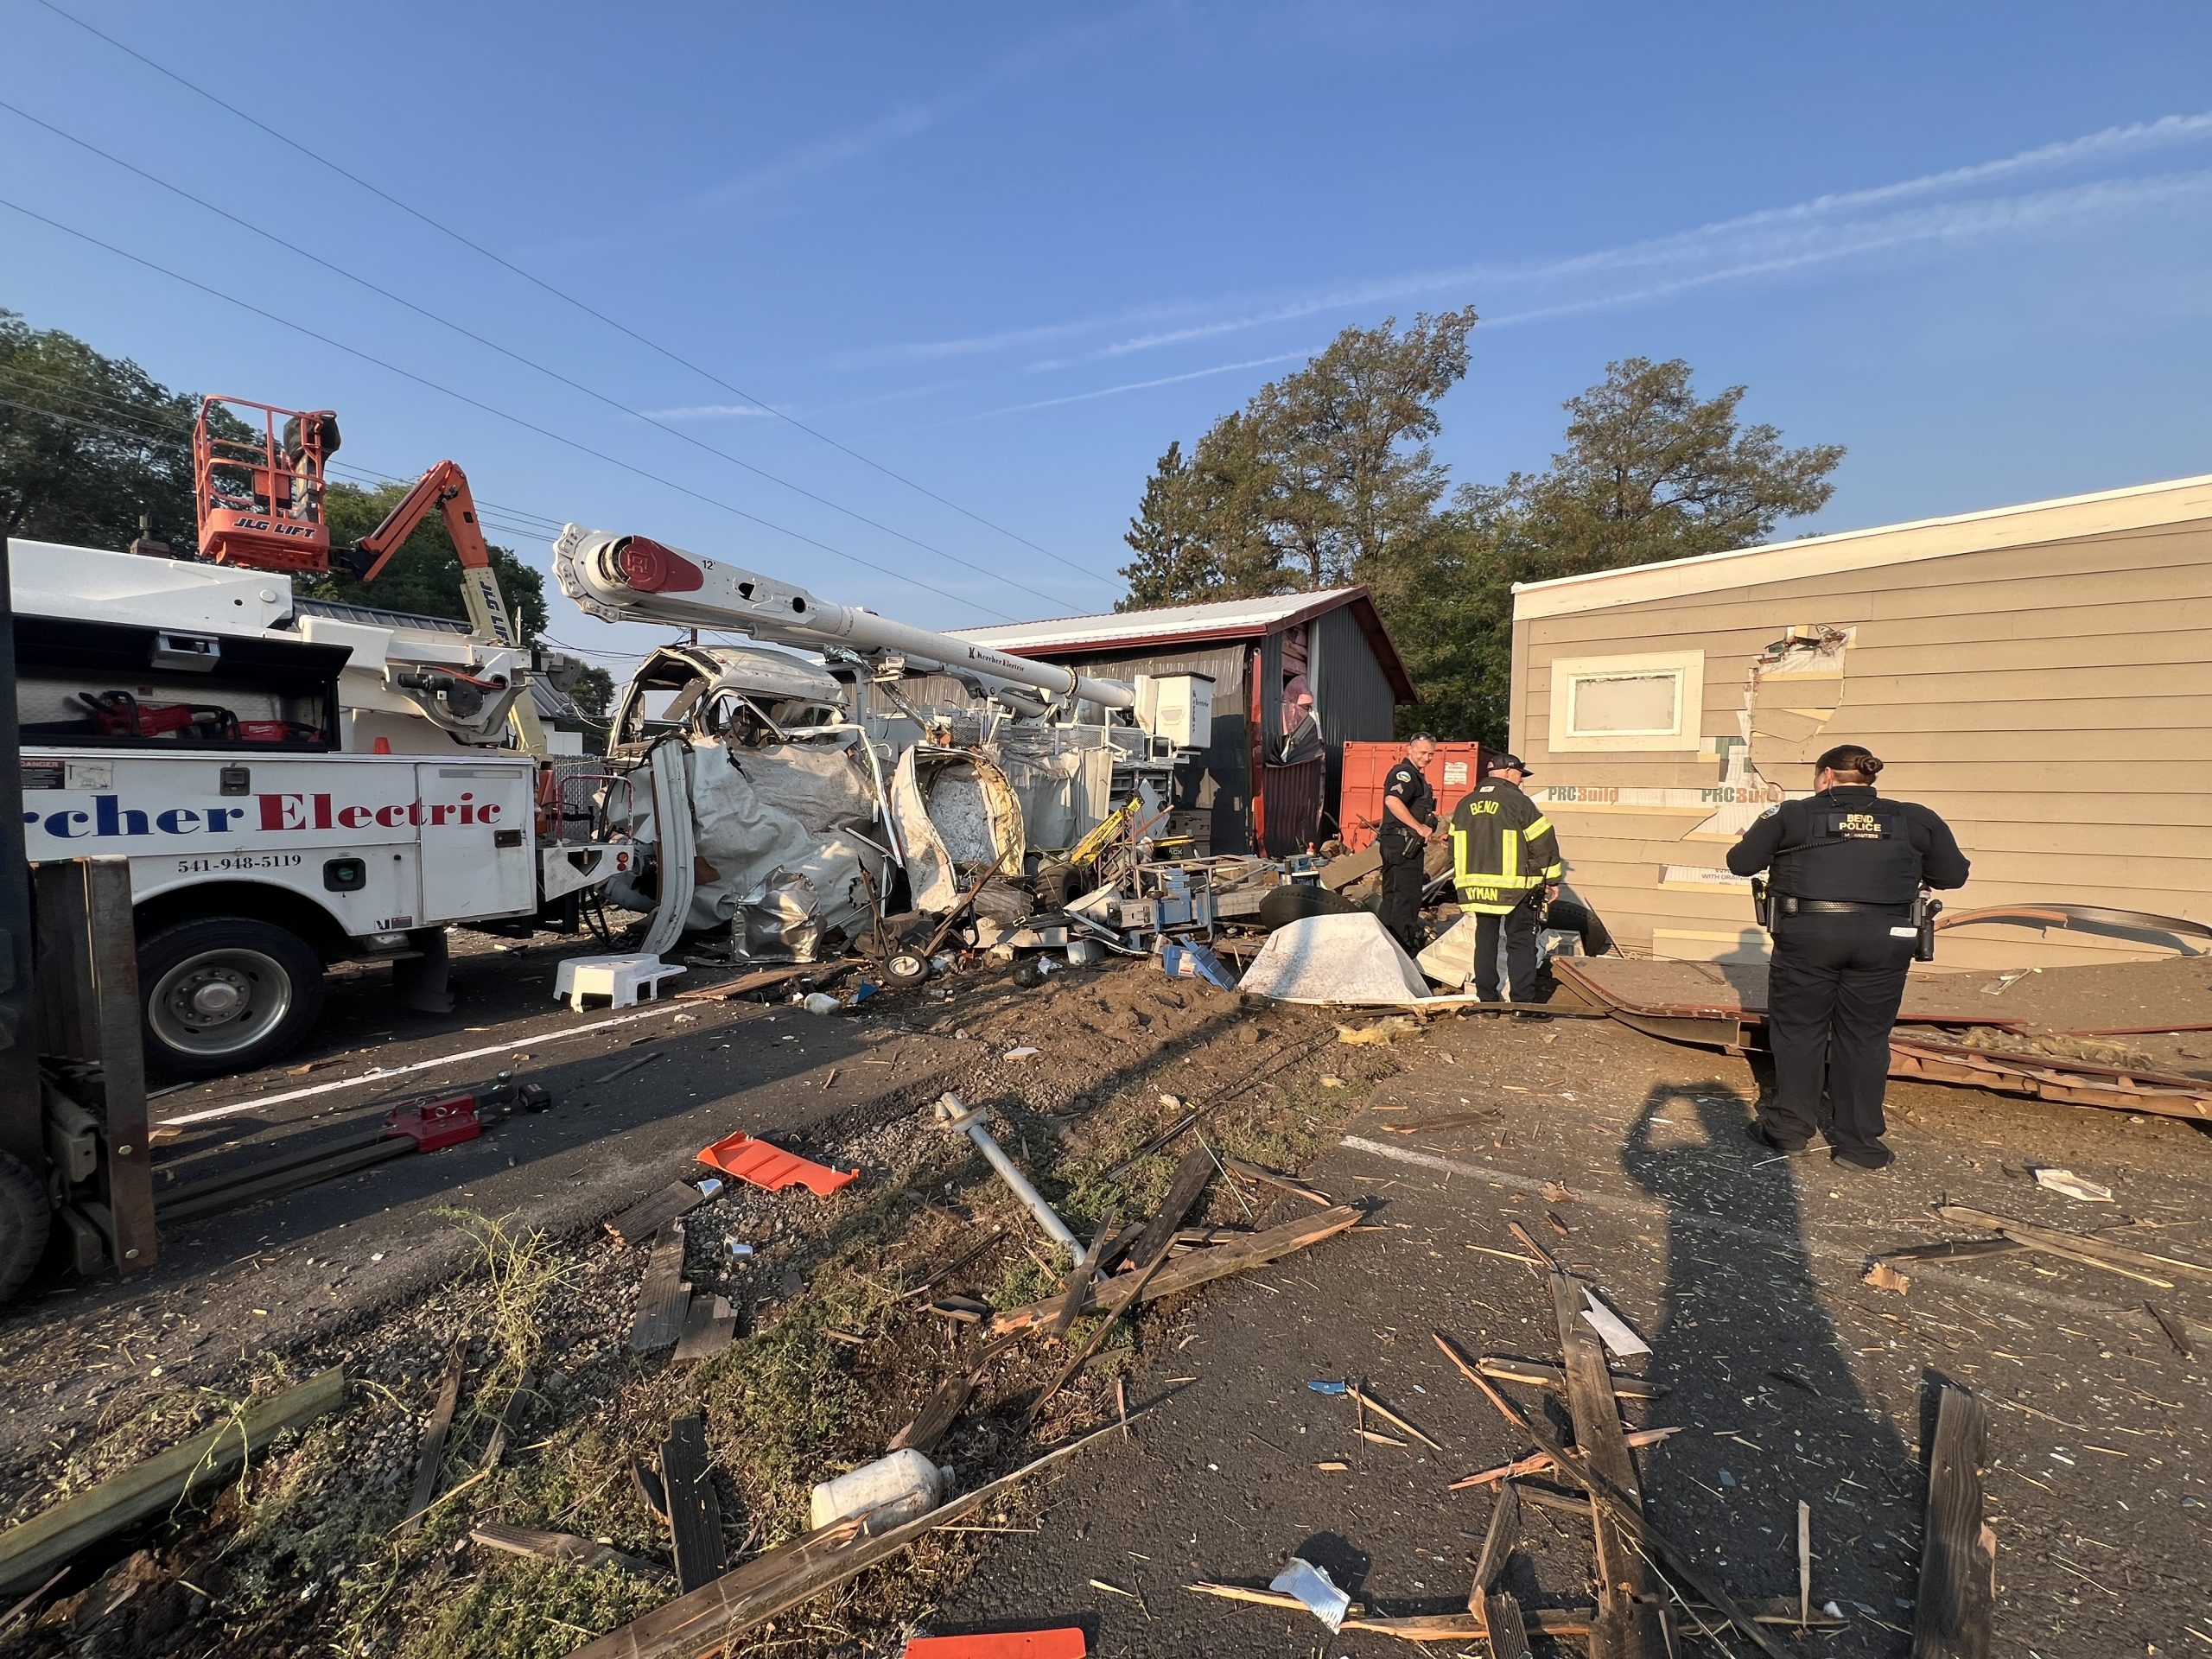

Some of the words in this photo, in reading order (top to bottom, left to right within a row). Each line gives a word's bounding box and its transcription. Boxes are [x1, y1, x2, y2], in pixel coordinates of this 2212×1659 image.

[232, 518, 271, 531] JLG
[273, 523, 316, 538] LIFT
[479, 580, 500, 612] JLG
[1002, 658, 1025, 672] Electric
[252, 792, 501, 831] Electric
[1469, 800, 1500, 817] BEND
[1839, 822, 1882, 832] POLICE
[1847, 814, 1874, 823] BEND
[178, 854, 302, 874] 541-948-5119
